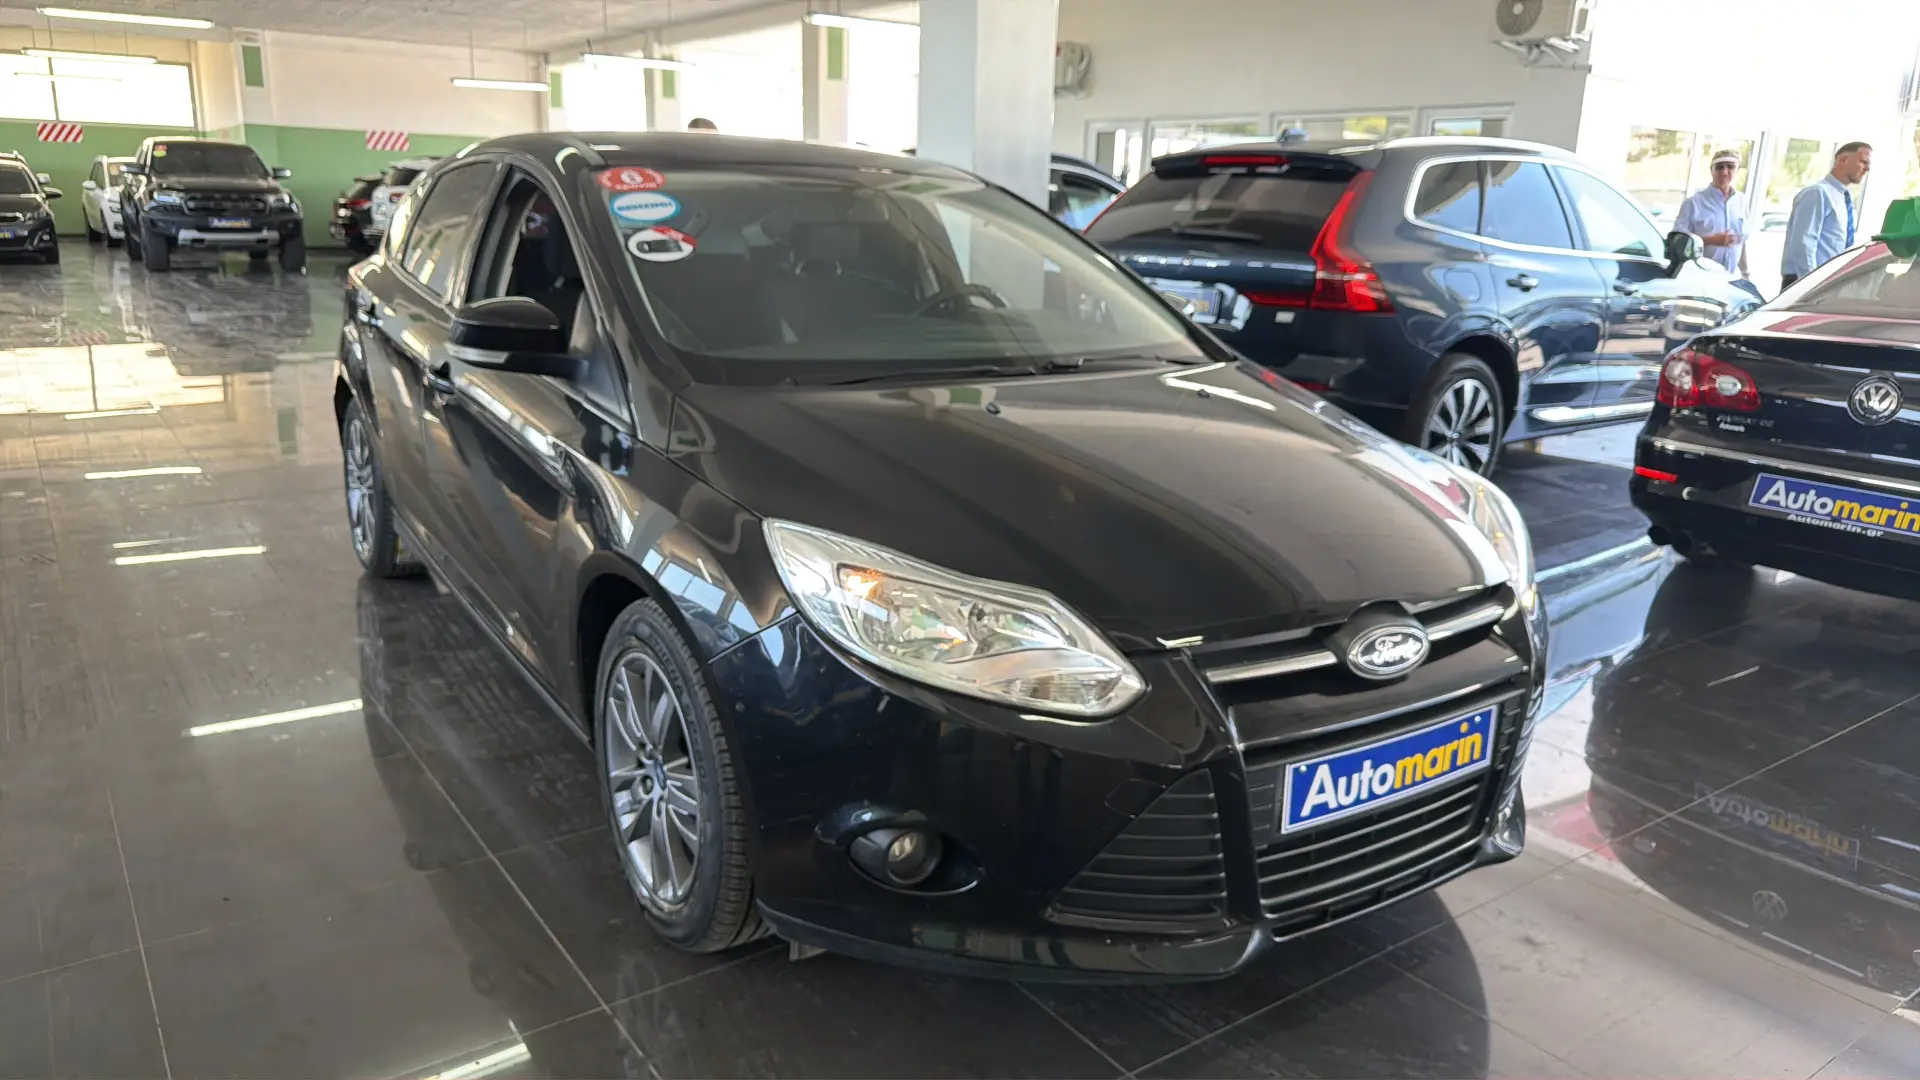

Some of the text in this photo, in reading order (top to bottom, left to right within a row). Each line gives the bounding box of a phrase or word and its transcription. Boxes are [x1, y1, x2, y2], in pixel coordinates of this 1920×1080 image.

[1759, 479, 1920, 532] Automarin
[1787, 513, 1884, 538] Automarin.gr
[1360, 633, 1423, 666] Ford
[1300, 721, 1483, 818] Automarin
